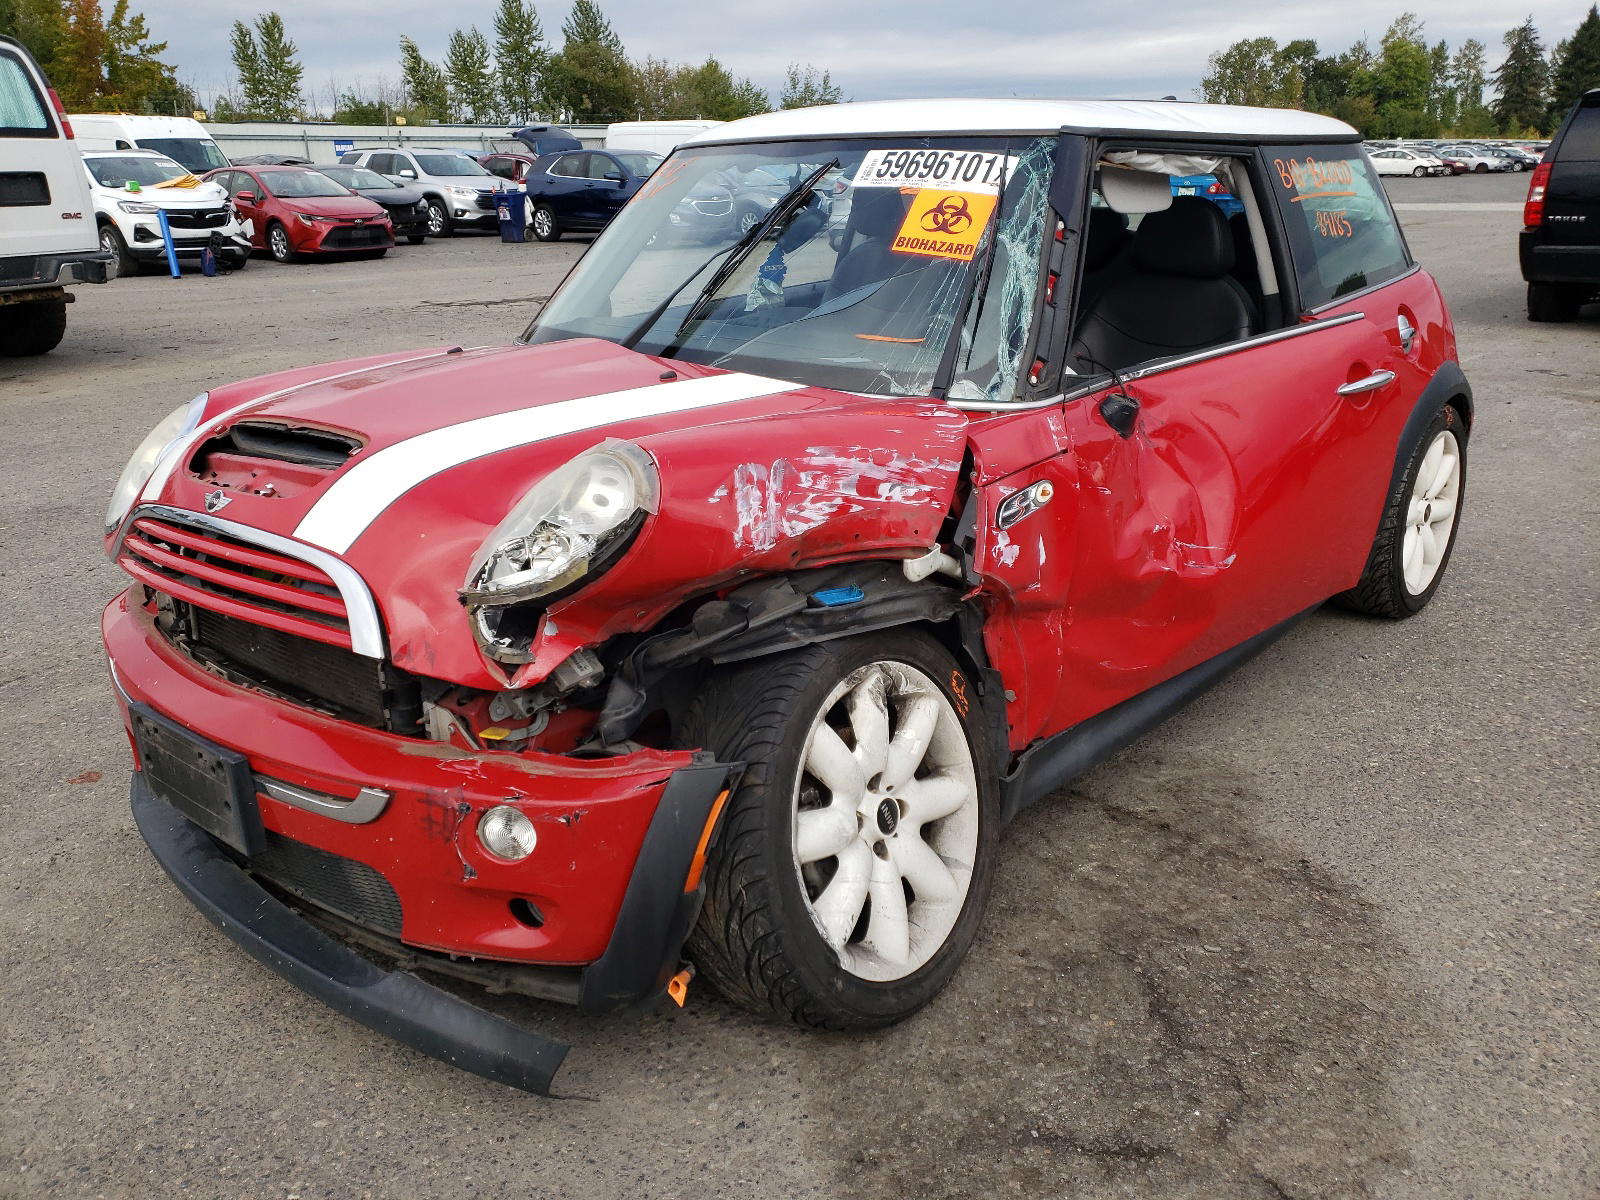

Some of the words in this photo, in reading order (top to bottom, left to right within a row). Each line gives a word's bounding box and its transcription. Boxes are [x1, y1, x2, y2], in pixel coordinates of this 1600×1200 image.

[61, 212, 83, 220] GMC
[895, 236, 975, 256] BIOHAZARD
[880, 803, 895, 830] MINI
